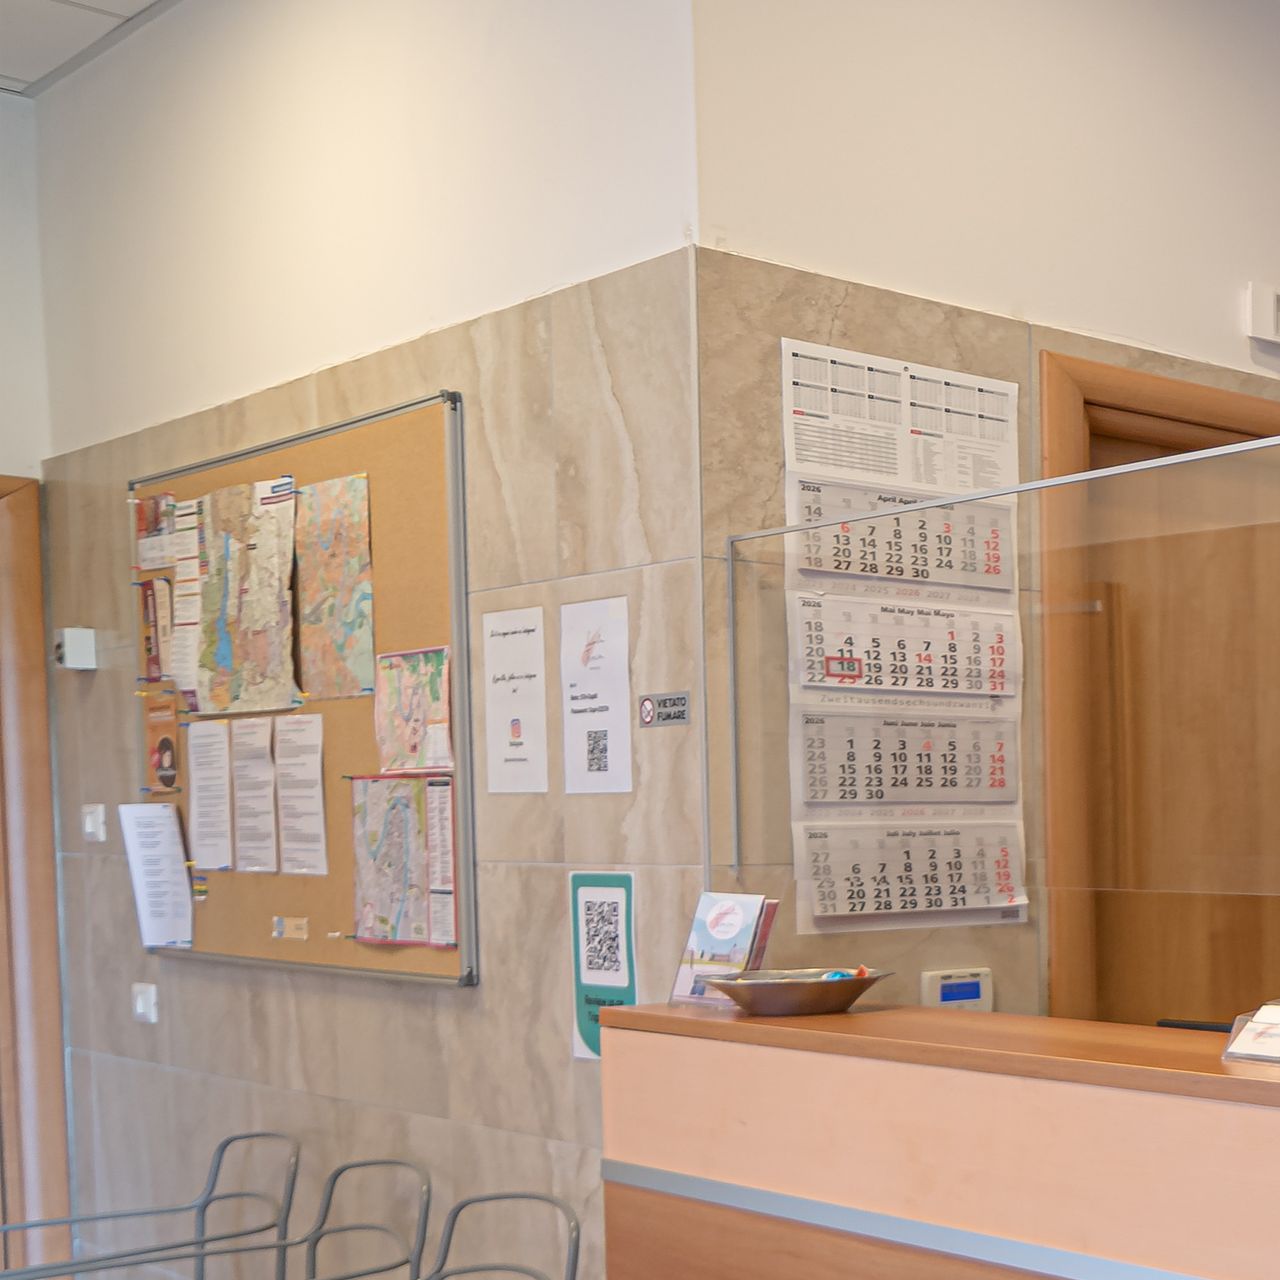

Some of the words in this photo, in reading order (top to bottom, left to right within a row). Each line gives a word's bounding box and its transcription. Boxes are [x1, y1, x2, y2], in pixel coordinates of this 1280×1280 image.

[801, 484, 821, 493] 2026
[805, 506, 823, 516] 14
[894, 518, 900, 526] 1
[919, 520, 926, 530] 2
[944, 523, 952, 533] 3
[991, 529, 999, 539] 5
[841, 522, 849, 533] 6
[868, 526, 876, 535] 7
[894, 529, 902, 539] 8
[920, 532, 927, 542] 9
[936, 535, 952, 545] 10
[984, 541, 1000, 550] 12
[834, 535, 850, 545] 13
[860, 538, 877, 548] 14
[886, 541, 902, 551] 15
[912, 544, 928, 554] 16
[937, 547, 952, 556] 17
[985, 553, 1000, 562] 19
[833, 547, 851, 558] 20
[860, 551, 877, 561] 21
[886, 554, 902, 564] 22
[911, 557, 928, 566] 23
[936, 559, 953, 569] 24
[985, 565, 1001, 574] 26
[834, 560, 851, 570] 27
[860, 563, 878, 573] 28
[886, 566, 904, 576] 29
[912, 568, 929, 579] 30
[948, 631, 954, 640] 1
[973, 633, 979, 641] 2
[996, 634, 1003, 643] 3
[844, 637, 854, 646] 4
[872, 638, 879, 648] 5
[898, 640, 905, 650] 6
[923, 641, 931, 650] 7
[949, 644, 956, 652] 8
[973, 645, 980, 654] 9
[989, 646, 1005, 655] 10
[838, 649, 853, 658] 11
[865, 651, 881, 660] 12
[890, 652, 906, 662] 13
[917, 654, 932, 664] 14
[942, 655, 957, 664] 15
[966, 656, 981, 665] 16
[991, 658, 1005, 667] 17
[838, 662, 855, 671] 18
[866, 664, 882, 673] 19
[890, 665, 908, 674] 20
[916, 666, 932, 675] 21
[941, 667, 957, 676] 22
[966, 669, 982, 678] 23
[990, 670, 1005, 679] 24
[865, 676, 883, 685] 26
[891, 677, 908, 686] 27
[917, 678, 934, 688] 28
[942, 679, 958, 688] 29
[966, 680, 982, 690] 30
[990, 682, 1005, 690] 31
[657, 697, 686, 707] VIETATO
[658, 710, 686, 721] FUMARE
[847, 740, 854, 748] 1
[873, 740, 881, 749] 2
[899, 740, 906, 750] 3
[923, 741, 932, 750] 4
[948, 741, 956, 751] 5
[997, 742, 1004, 750] 7
[847, 752, 855, 761] 8
[874, 753, 881, 762] 9
[891, 753, 907, 762] 10
[917, 754, 931, 763] 11
[941, 754, 956, 763] 12
[990, 755, 1005, 763] 14
[840, 765, 856, 774] 15
[865, 765, 882, 774] 16
[892, 766, 907, 774] 17
[917, 766, 932, 775] 18
[942, 766, 957, 775] 19
[990, 767, 1004, 775] 21
[839, 777, 856, 787] 22
[865, 777, 883, 787] 23
[891, 778, 908, 787] 24
[917, 778, 933, 787] 25
[941, 778, 957, 787] 26
[990, 778, 1005, 788] 28
[840, 790, 857, 799] 29
[866, 790, 884, 799] 30
[904, 851, 910, 860] 1
[928, 850, 936, 859] 2
[953, 849, 961, 858] 3
[1001, 848, 1008, 857] 5
[852, 864, 860, 874] 6
[879, 863, 886, 873] 7
[904, 863, 912, 872] 8
[930, 862, 937, 871] 9
[946, 861, 962, 870] 10
[995, 860, 1009, 868] 12
[847, 890, 865, 899] 20
[874, 889, 890, 898] 21
[900, 888, 916, 897] 22
[925, 886, 941, 896] 23
[950, 885, 966, 894] 24
[849, 902, 865, 912] 27
[874, 901, 892, 910] 28
[900, 899, 917, 909] 29
[926, 898, 943, 907] 30
[952, 897, 966, 906] 31
[1008, 895, 1015, 903] 2
